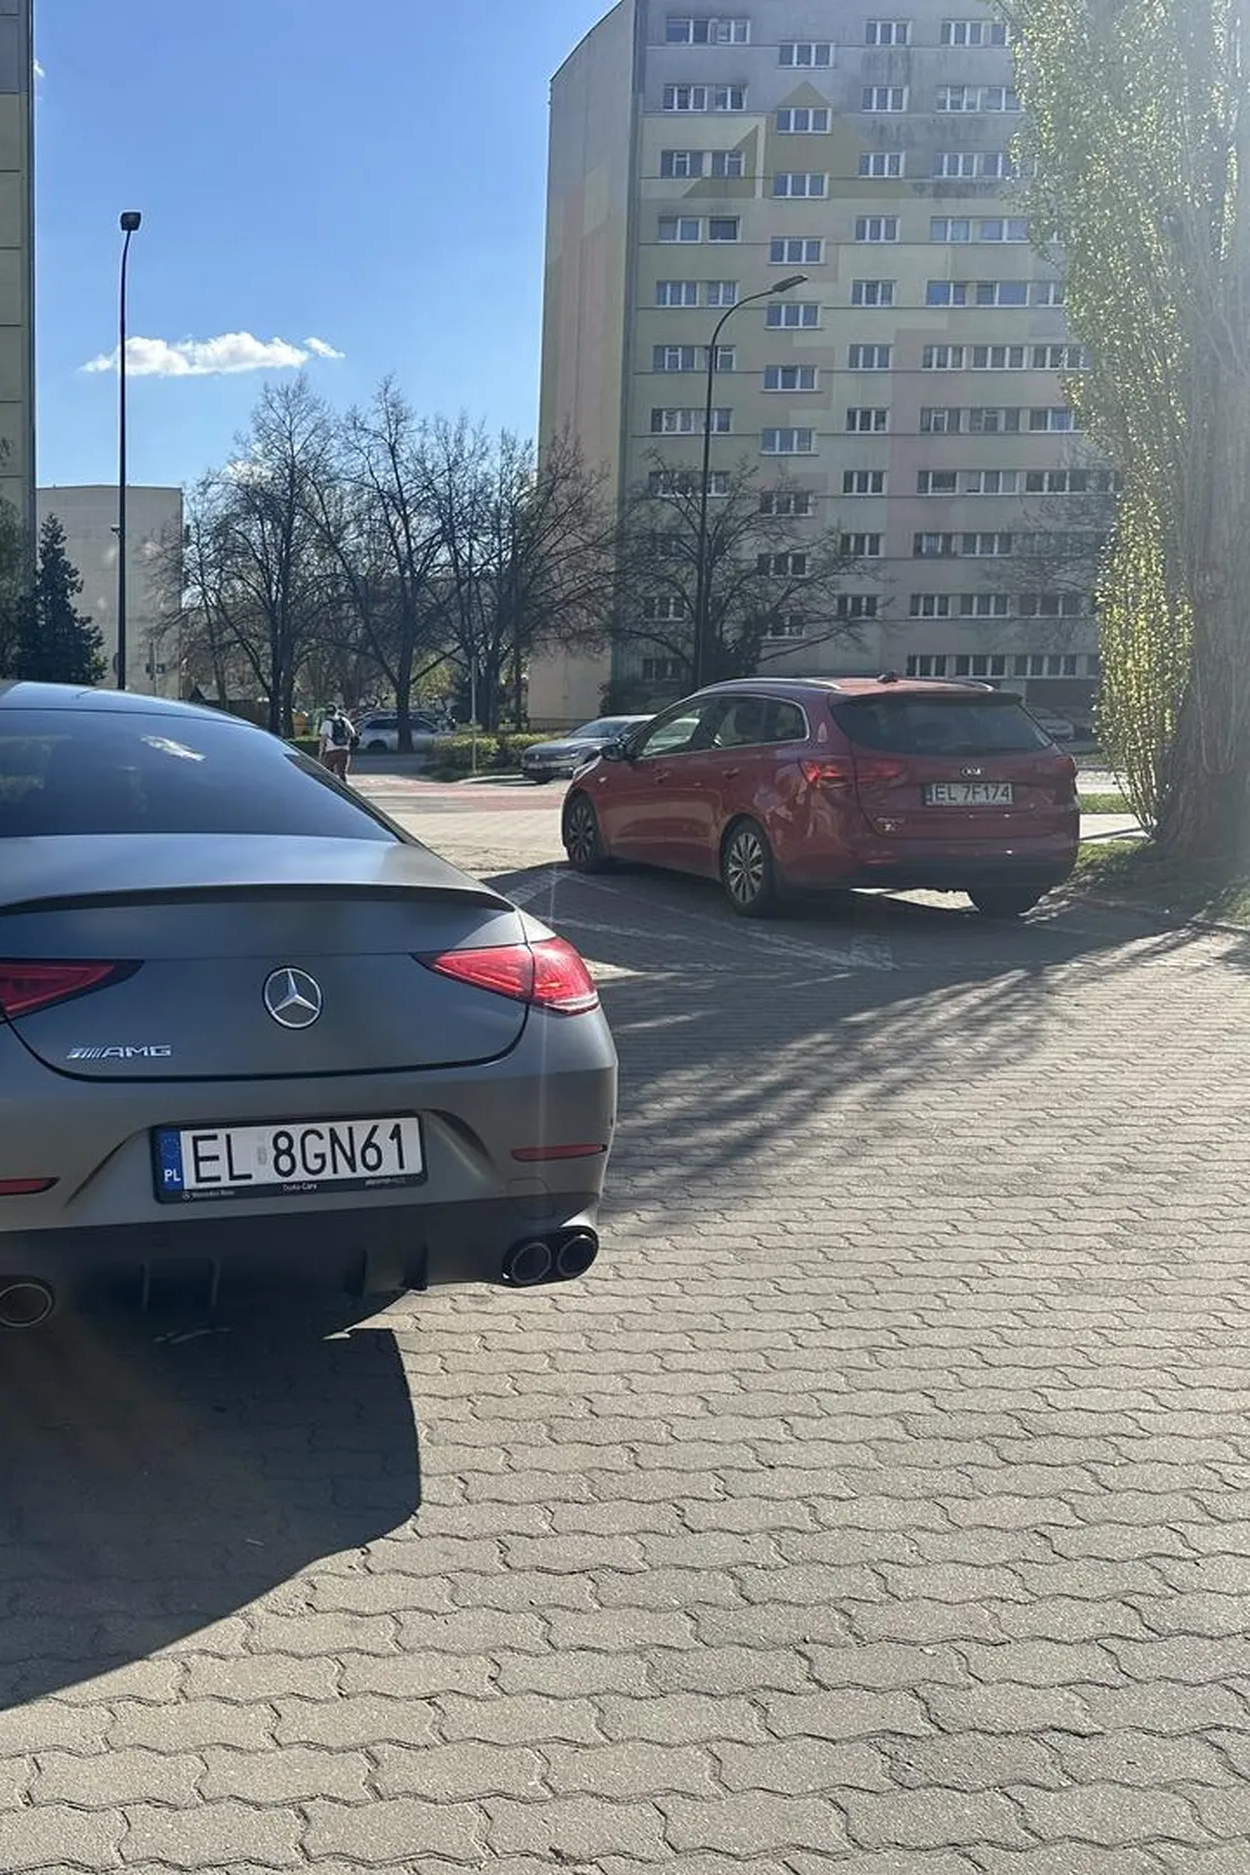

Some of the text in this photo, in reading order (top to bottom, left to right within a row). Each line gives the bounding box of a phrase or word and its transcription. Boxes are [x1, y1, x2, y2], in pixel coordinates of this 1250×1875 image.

[935, 784, 1010, 801] EL 7F174
[102, 1045, 172, 1058] AMG
[191, 1123, 405, 1183] EL 8GN61
[163, 1169, 181, 1182] PL
